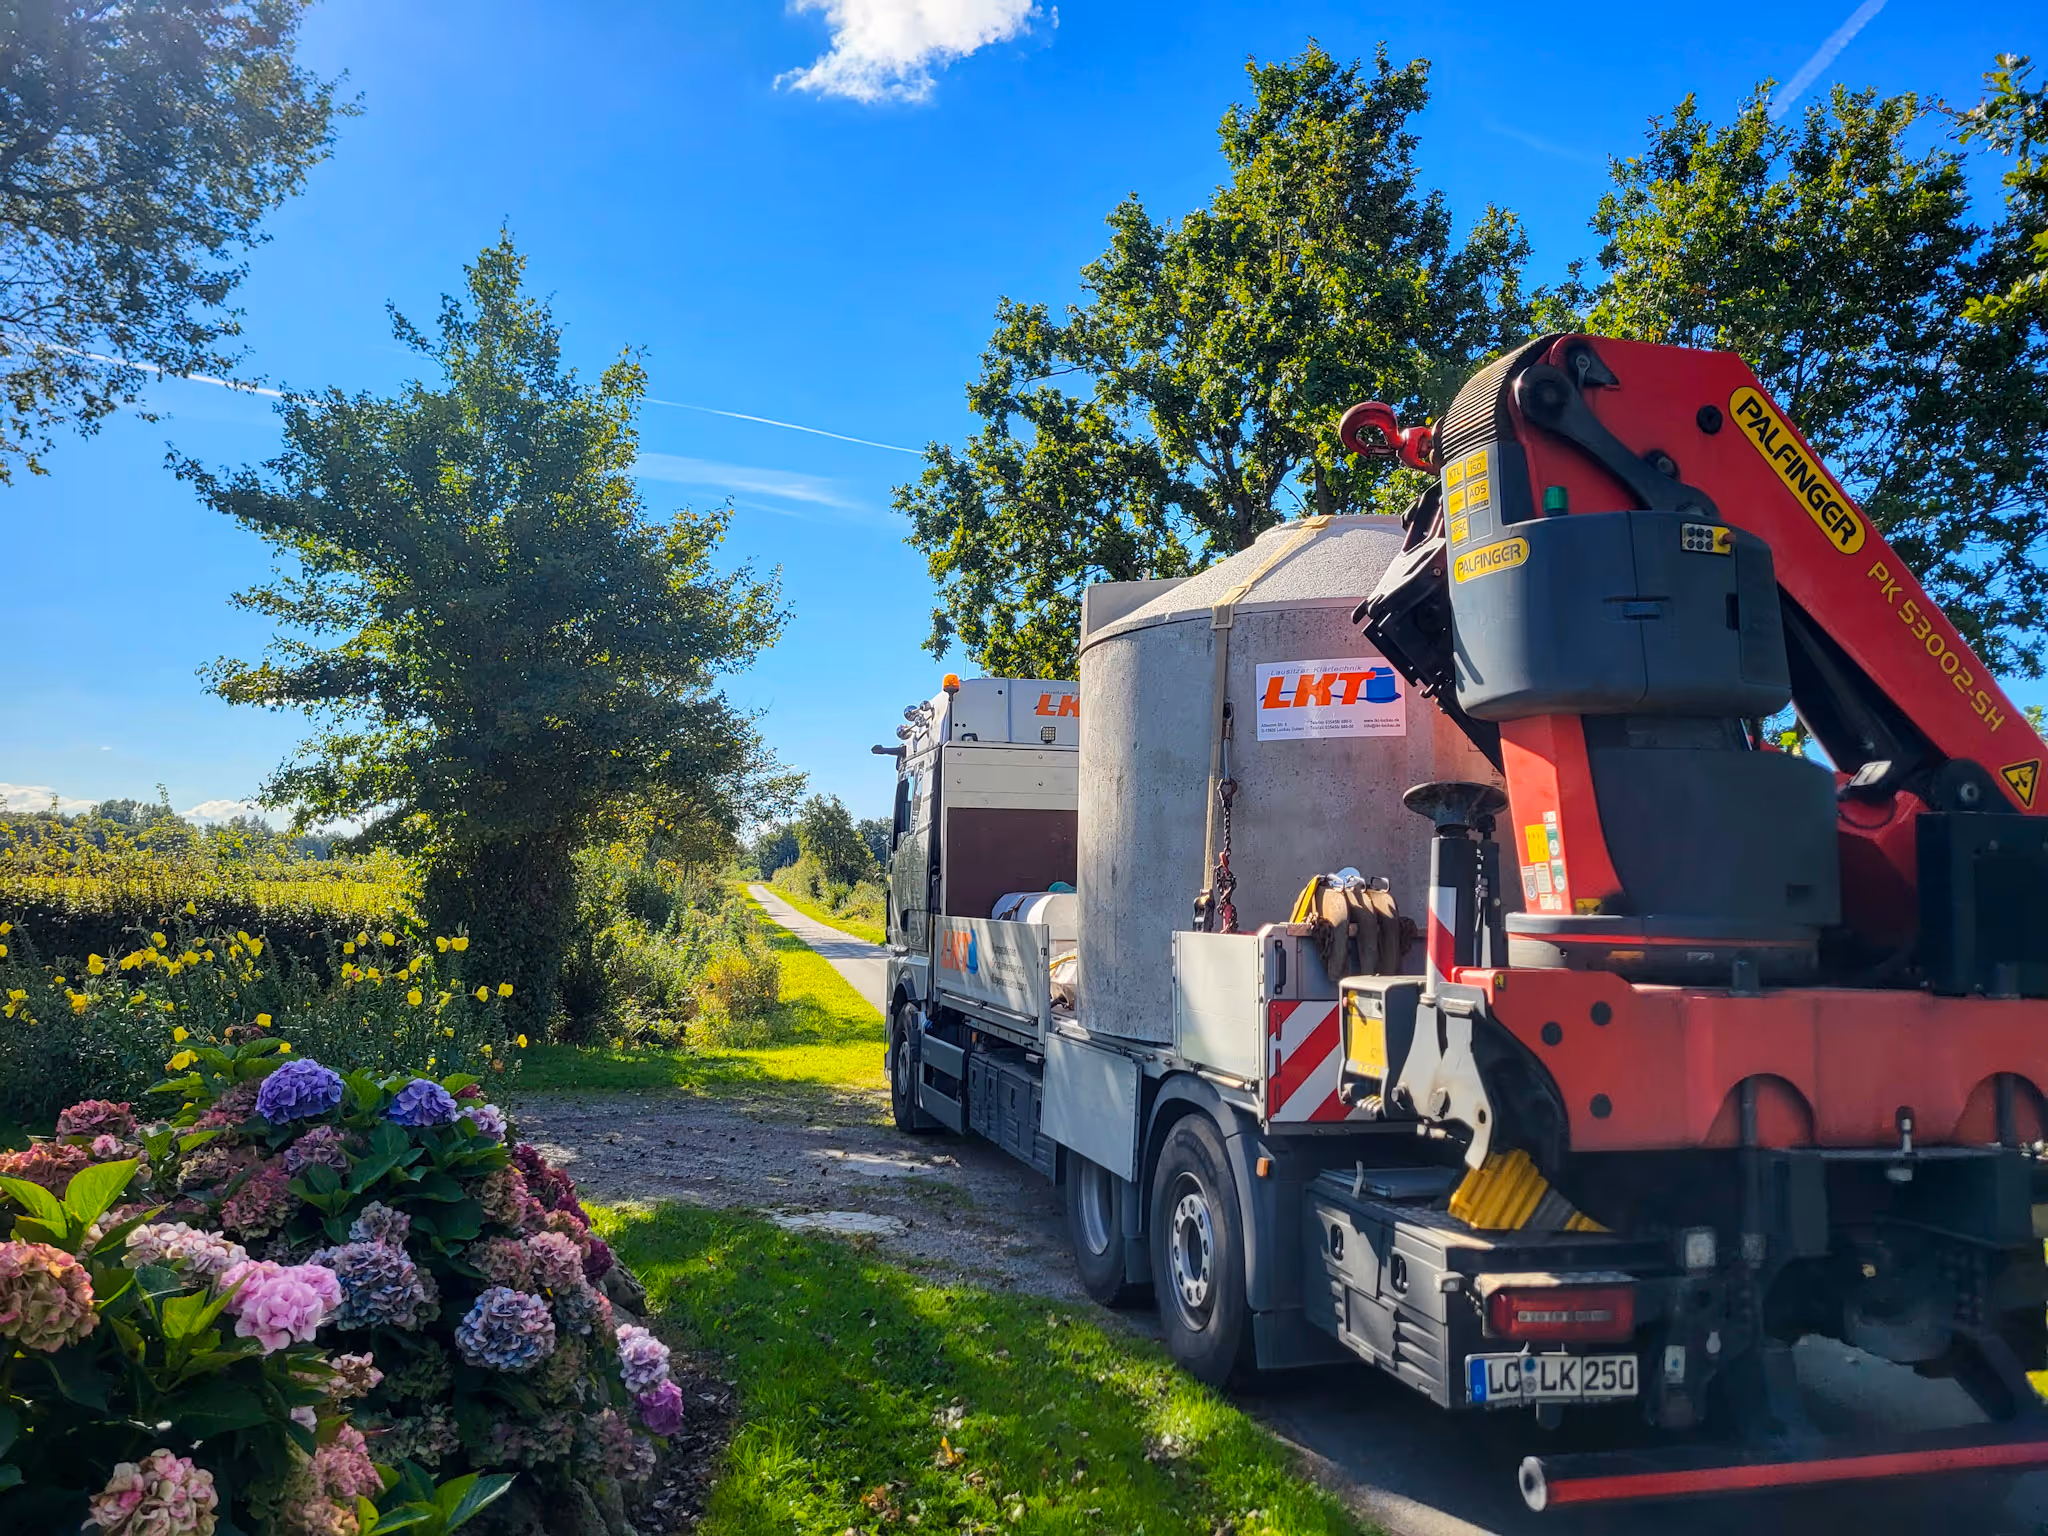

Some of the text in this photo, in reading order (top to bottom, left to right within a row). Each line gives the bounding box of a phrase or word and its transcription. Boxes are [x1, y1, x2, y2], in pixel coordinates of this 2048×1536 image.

[1735, 394, 1857, 547] PALFINGER
[1469, 483, 1487, 499] AOS
[1457, 543, 1522, 577] PALFINGER
[1866, 560, 2006, 732] PK 53002-SH
[1262, 672, 1376, 709] LKT
[941, 930, 972, 973] LKT
